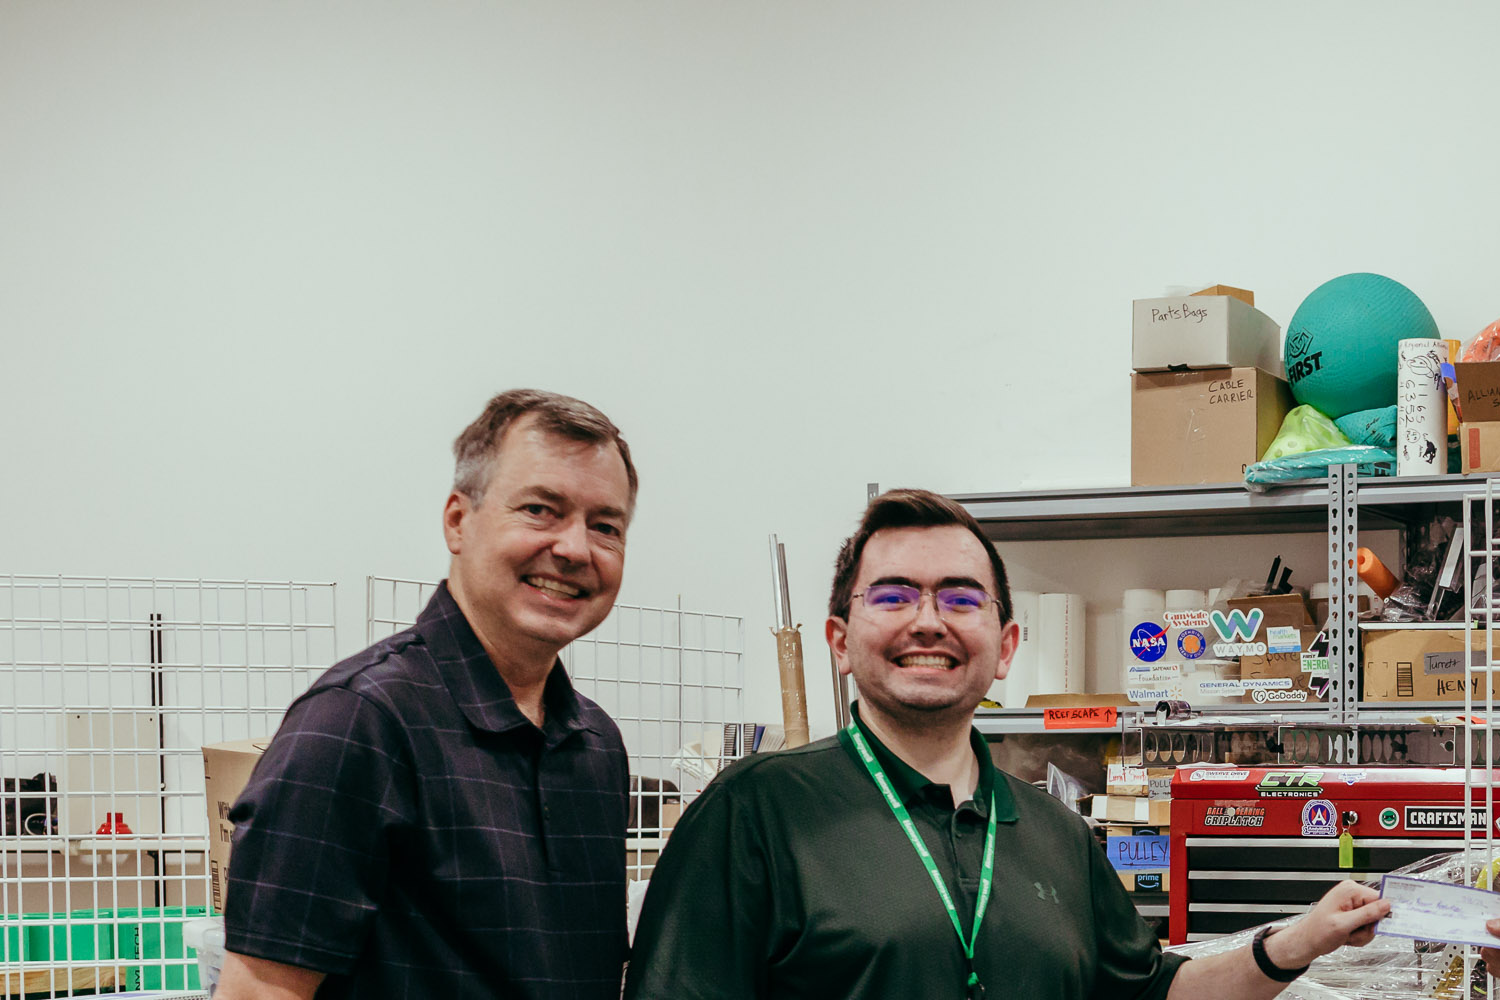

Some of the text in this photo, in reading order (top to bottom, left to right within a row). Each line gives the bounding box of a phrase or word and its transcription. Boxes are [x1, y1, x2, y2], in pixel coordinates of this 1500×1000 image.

[1287, 350, 1323, 388] FIRST
[1208, 378, 1244, 393] CABLE
[1209, 389, 1254, 405] CARRIER
[1164, 611, 1207, 620] CamMate
[1172, 619, 1208, 627] Systems
[1132, 637, 1166, 648] NASA
[1216, 644, 1265, 654] WAYMO
[1138, 674, 1171, 682] Foundation
[1129, 689, 1169, 699] Walmart
[1260, 771, 1325, 787] CTR
[1206, 807, 1224, 816] BALL
[1204, 815, 1264, 827] GRIPLATCH
[1118, 841, 1168, 862] PULLEY
[1137, 874, 1160, 883] prime
